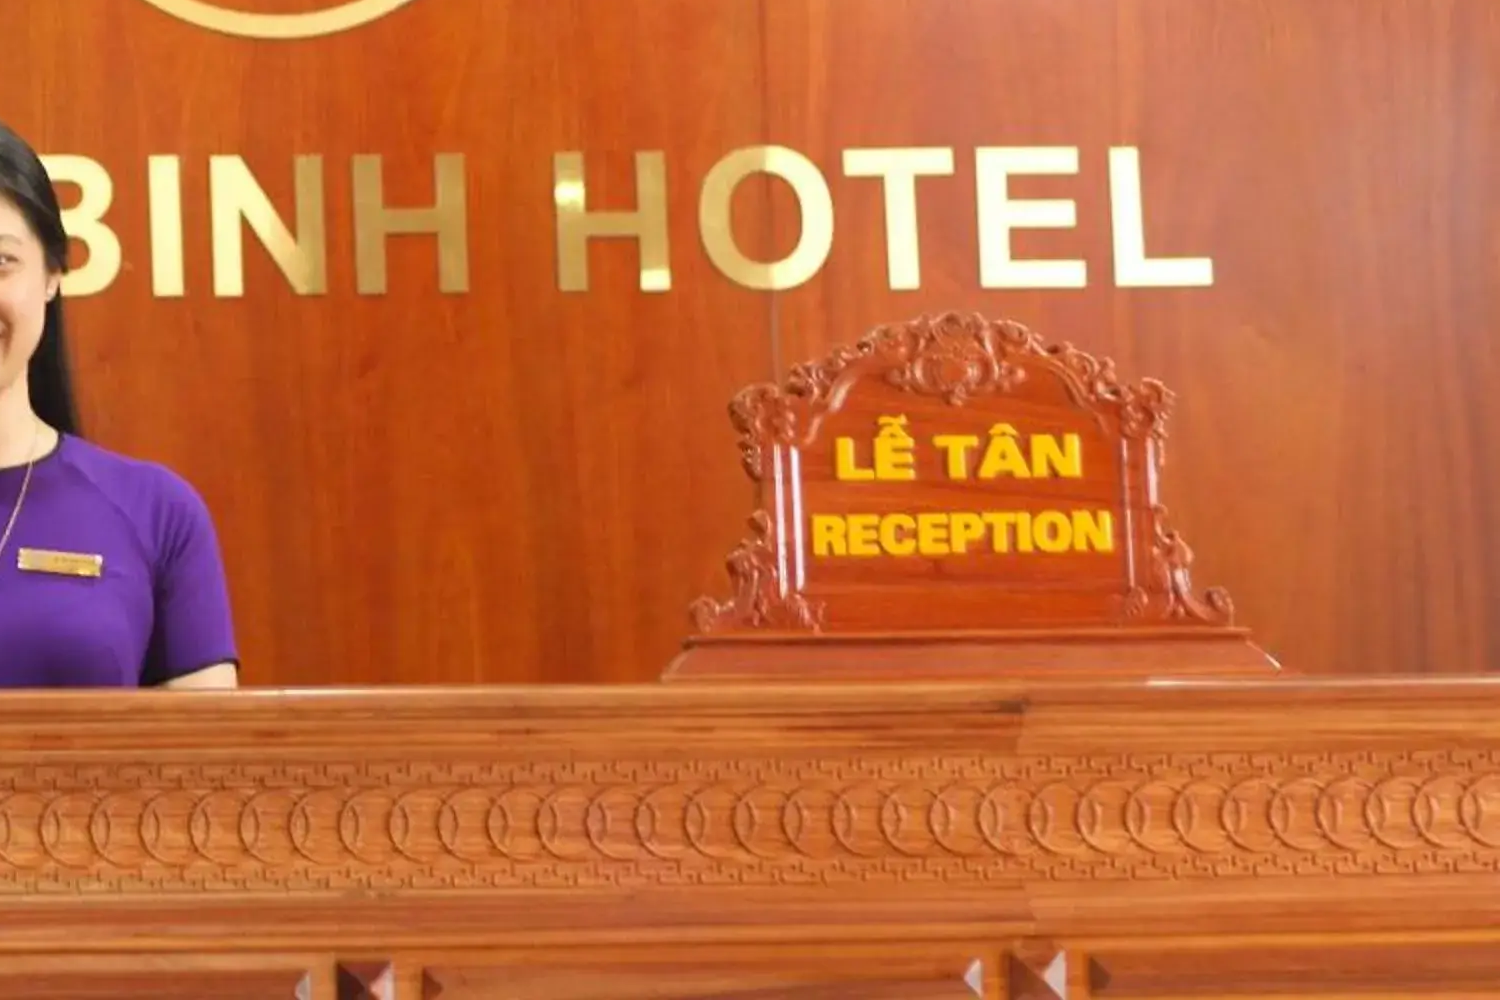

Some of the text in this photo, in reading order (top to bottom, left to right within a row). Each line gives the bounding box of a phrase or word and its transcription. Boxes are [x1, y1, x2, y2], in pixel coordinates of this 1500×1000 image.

[553, 145, 1213, 291] HOTEL
[836, 414, 1082, 480] LỄ TÂN
[812, 510, 1114, 556] RECEPTION
